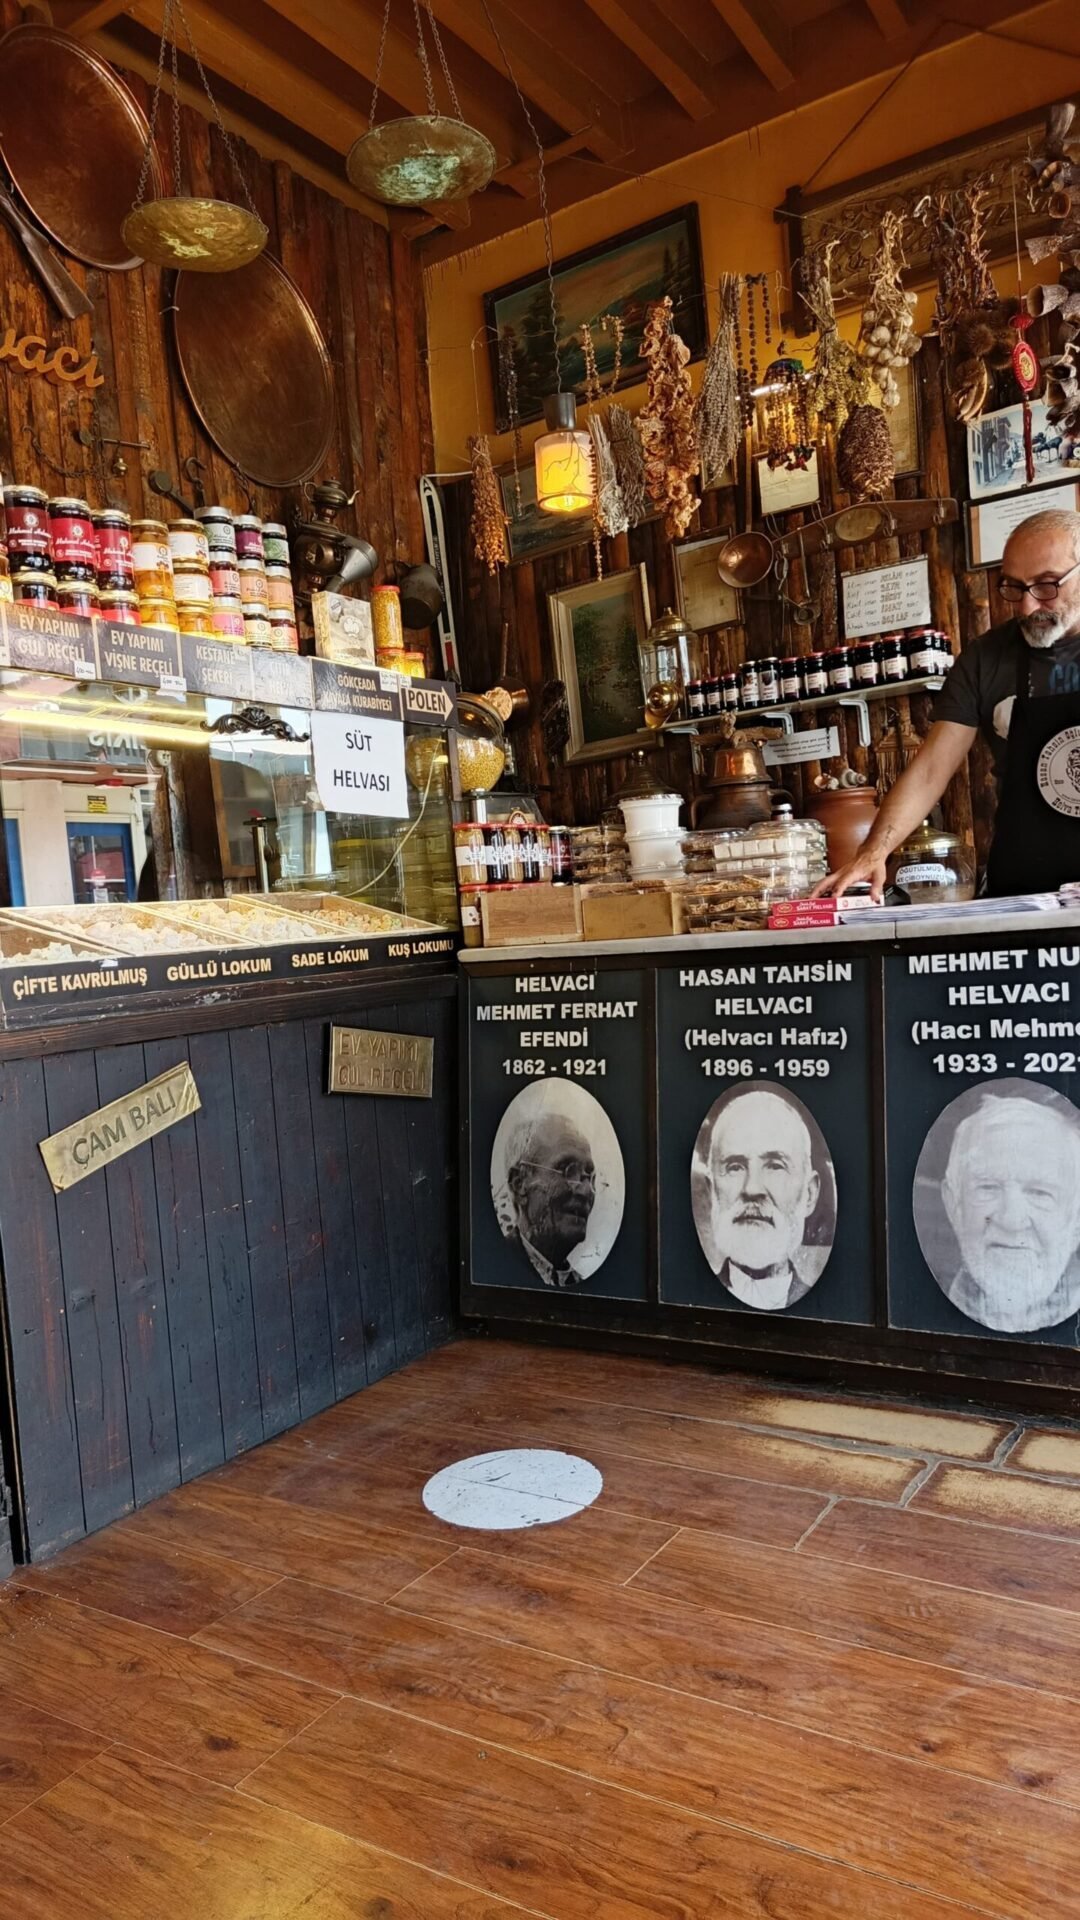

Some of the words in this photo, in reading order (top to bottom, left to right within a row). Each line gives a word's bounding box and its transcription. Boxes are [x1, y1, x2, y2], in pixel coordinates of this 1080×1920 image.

[19, 614, 35, 630] EV
[37, 617, 80, 638] YAPIMI
[111, 630, 125, 645] EV
[126, 633, 164, 652] YAPIMI
[47, 641, 86, 664] REÇELİ
[104, 649, 137, 672] VİŞNE
[139, 657, 173, 677] REÇELİ
[196, 645, 236, 665] KESTANE
[338, 671, 377, 692] GÖKÇEADA
[352, 694, 393, 712] KURABİYESİ
[408, 689, 446, 713] POLEN
[345, 730, 372, 752] SÜT
[333, 769, 390, 792] HELVASI
[292, 952, 325, 968] SADE
[328, 948, 369, 963] LOKUM
[388, 943, 410, 958] KUŞ
[412, 939, 454, 954] LOKUMU
[166, 961, 218, 981] GÜLLÜ
[221, 957, 272, 976] LOKUM
[909, 949, 1028, 974] MEHMET
[12, 975, 58, 1000] ÇİFTE
[61, 967, 148, 991] KAVRULMUŞ
[515, 974, 596, 993] HELVACI
[679, 967, 756, 987] HASAN
[763, 960, 852, 984] TAHSİN
[948, 982, 1070, 1005] HELVACI
[476, 1003, 555, 1021] MEHMET
[560, 1001, 638, 1019] FERHAT
[715, 996, 813, 1016] HELVACI
[520, 1027, 589, 1048] EFENDİ
[684, 1028, 773, 1051] (Helvacı
[780, 1027, 848, 1050] Hafız)
[911, 1020, 980, 1045] (Hacı
[338, 1031, 361, 1056] EV
[368, 1035, 419, 1062] YAPIMI
[502, 1059, 546, 1076] 1862
[562, 1059, 607, 1076] 1921
[700, 1059, 753, 1077] 1896
[774, 1058, 830, 1077] 1959
[933, 1053, 998, 1073] 1933
[72, 1116, 127, 1170] ÇAM
[129, 1086, 177, 1131] BALI
